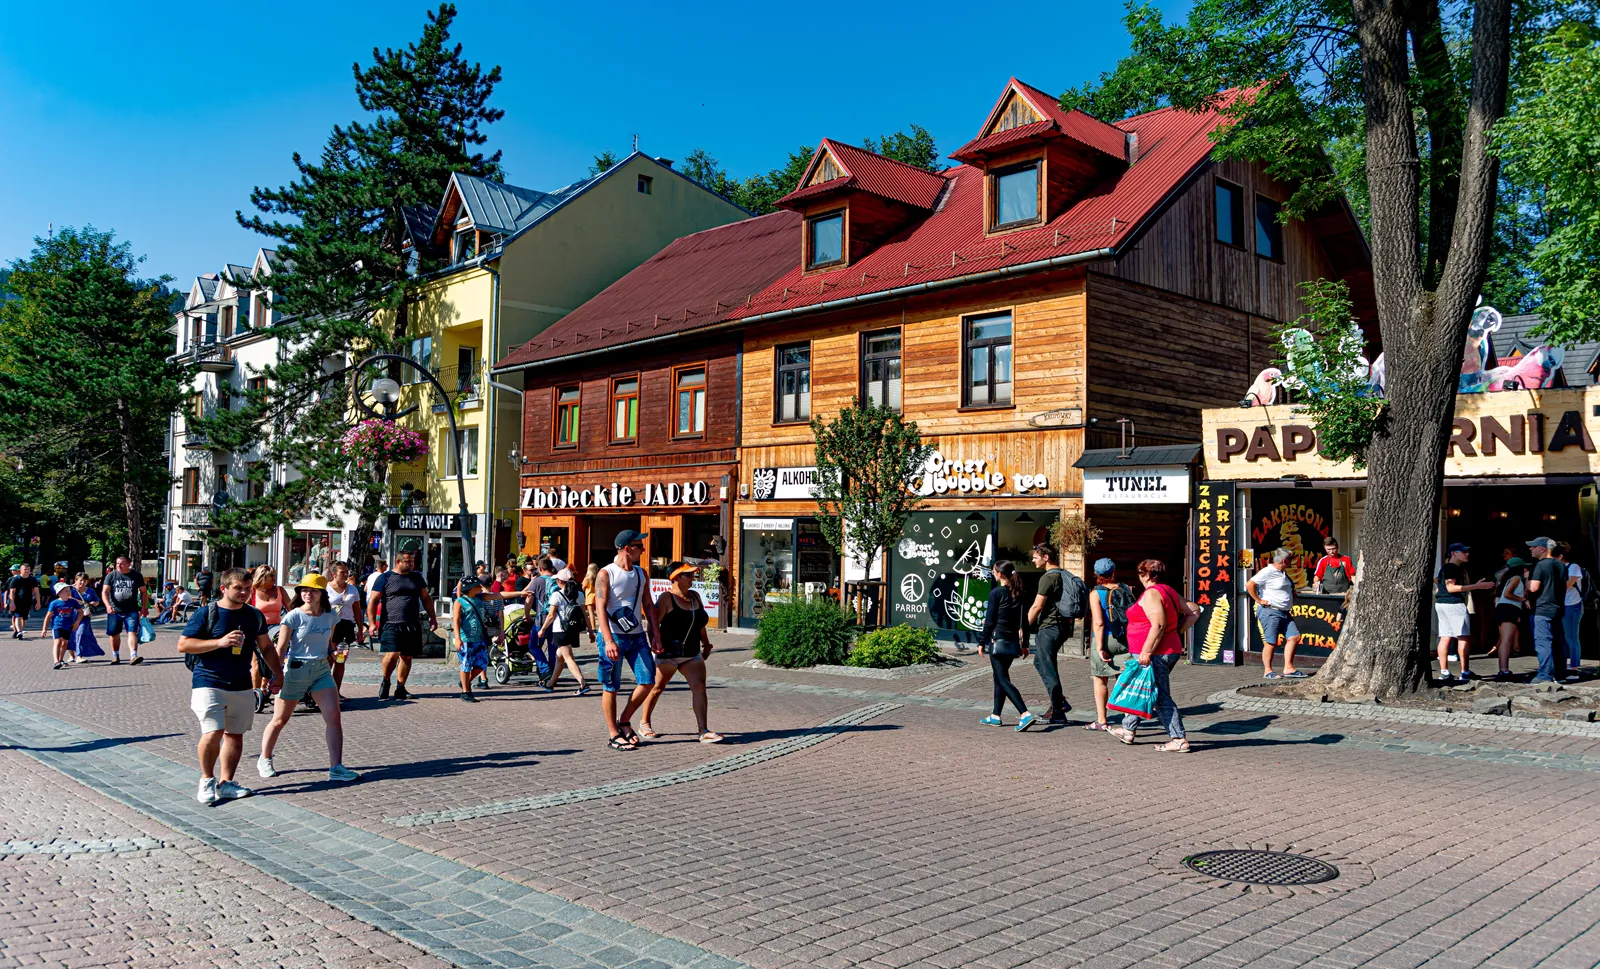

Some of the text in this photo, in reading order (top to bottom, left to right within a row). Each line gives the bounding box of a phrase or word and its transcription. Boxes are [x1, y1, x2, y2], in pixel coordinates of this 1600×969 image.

[1216, 410, 1597, 463] PAPRNIA
[1011, 472, 1048, 492] tea
[1105, 476, 1167, 491] TUNEL
[641, 480, 707, 506] JADŁO
[398, 514, 454, 530] GREY WOLF
[1197, 485, 1211, 606] ZAKRĘCONA
[1215, 495, 1231, 583] FRYTKA
[114, 579, 135, 588] NEW
[895, 602, 927, 613] PARROT
[1277, 633, 1337, 650] FYTKA
